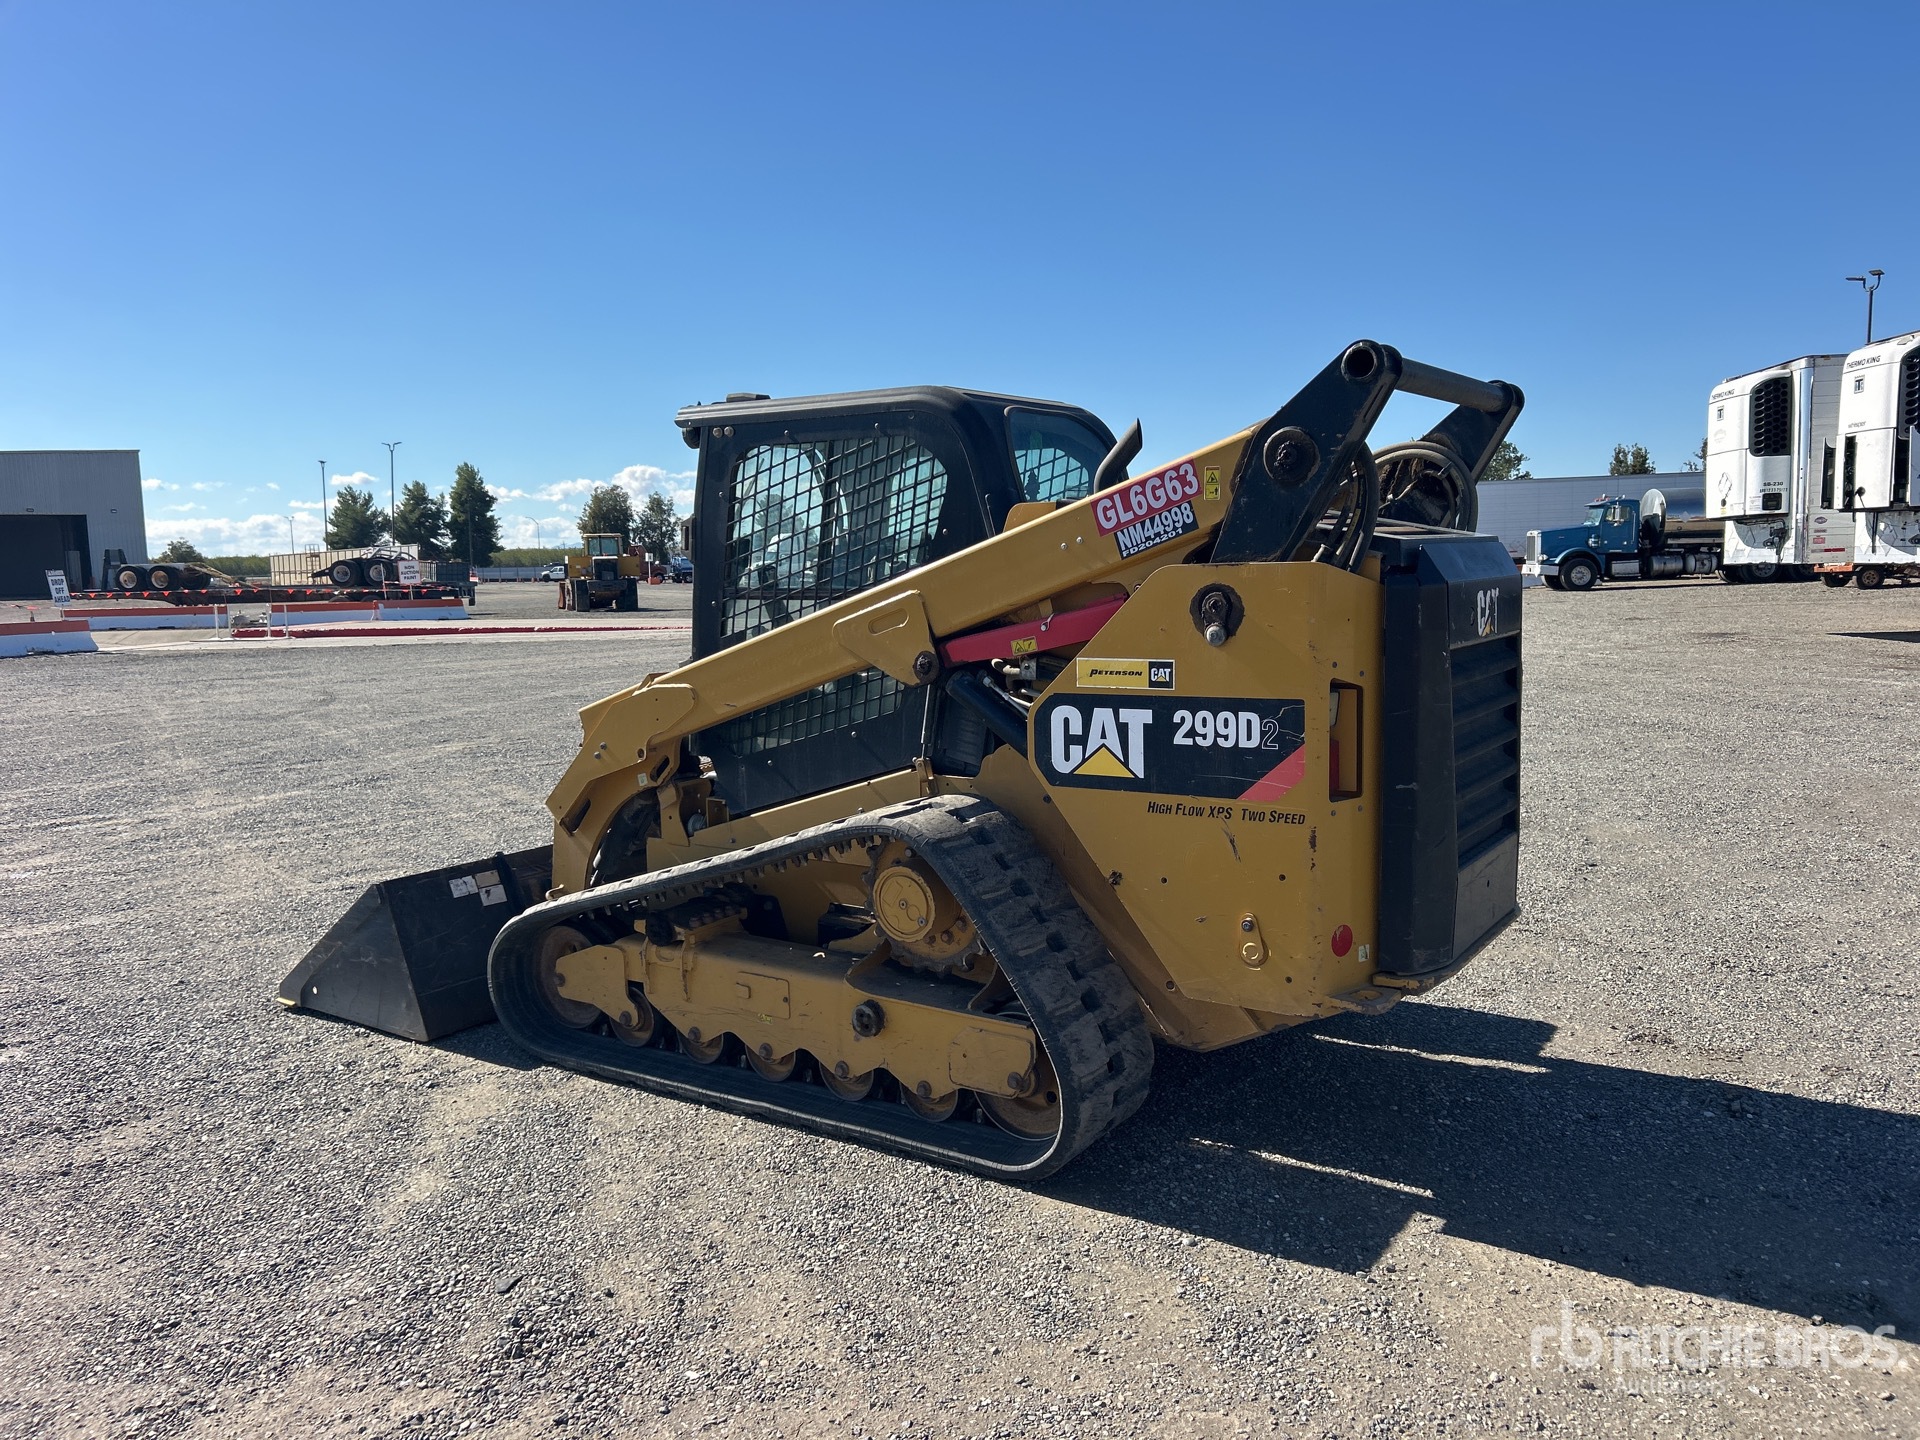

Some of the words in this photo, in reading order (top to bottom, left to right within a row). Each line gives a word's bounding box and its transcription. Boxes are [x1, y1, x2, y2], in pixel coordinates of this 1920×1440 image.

[1866, 355, 1881, 364] KING
[1096, 463, 1199, 530] GL6G63
[1116, 502, 1194, 551] NM44998
[1122, 528, 1183, 557] FD204201
[50, 578, 64, 586] DROP
[1089, 668, 1143, 677] PETERSON
[1150, 667, 1171, 682] CAT
[1050, 705, 1153, 779] CAT
[1147, 801, 1172, 815] HIGH
[1175, 803, 1205, 817] FLOW
[1208, 805, 1233, 820] XPS
[1241, 808, 1266, 823] TWO
[1268, 810, 1306, 825] SPEED
